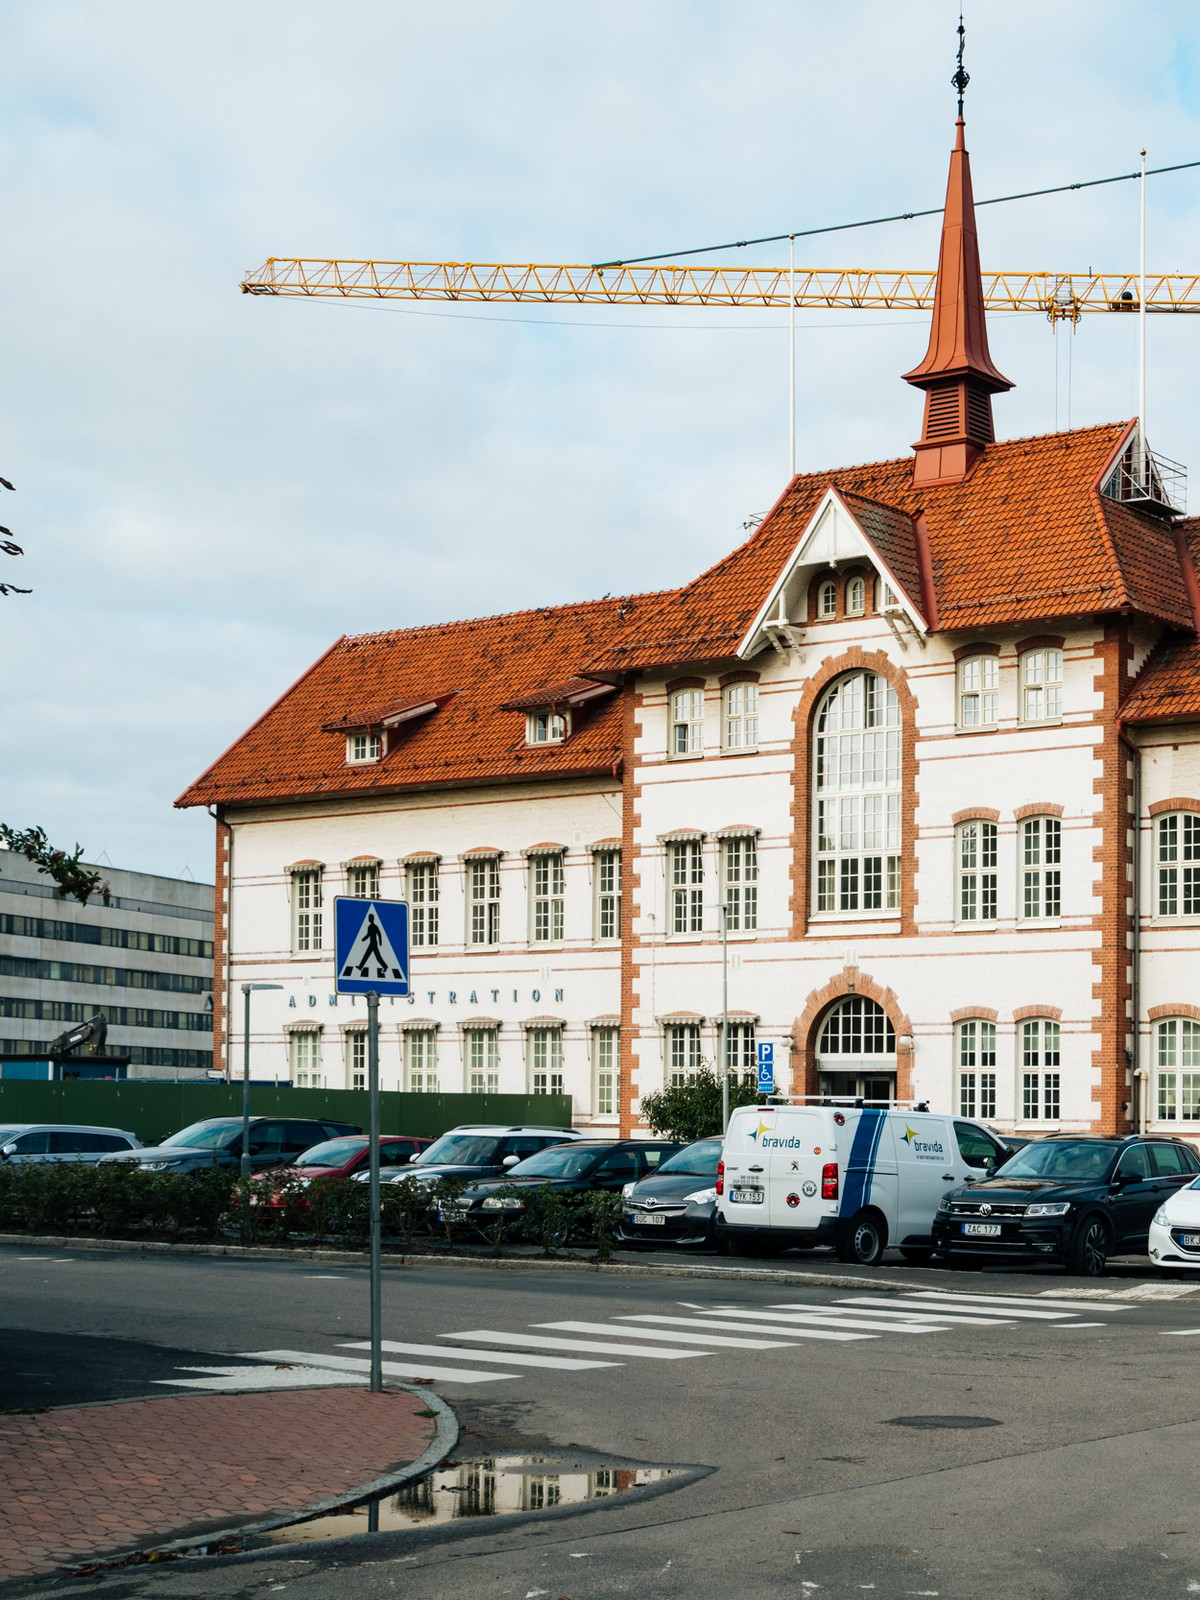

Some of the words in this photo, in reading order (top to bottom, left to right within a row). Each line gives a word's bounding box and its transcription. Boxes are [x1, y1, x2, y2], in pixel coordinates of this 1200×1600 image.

[288, 988, 564, 1008] ADMIISTRATION
[761, 1044, 771, 1061] P
[762, 1135, 801, 1149] bravida
[913, 1139, 944, 1153] bravida
[734, 1192, 747, 1201] OYK
[749, 1193, 761, 1202] 153
[635, 1215, 648, 1224] SUC
[651, 1216, 664, 1224] 107
[967, 1224, 982, 1234] ZAC
[984, 1225, 998, 1235] 177
[1185, 1236, 1200, 1245] BKJ
